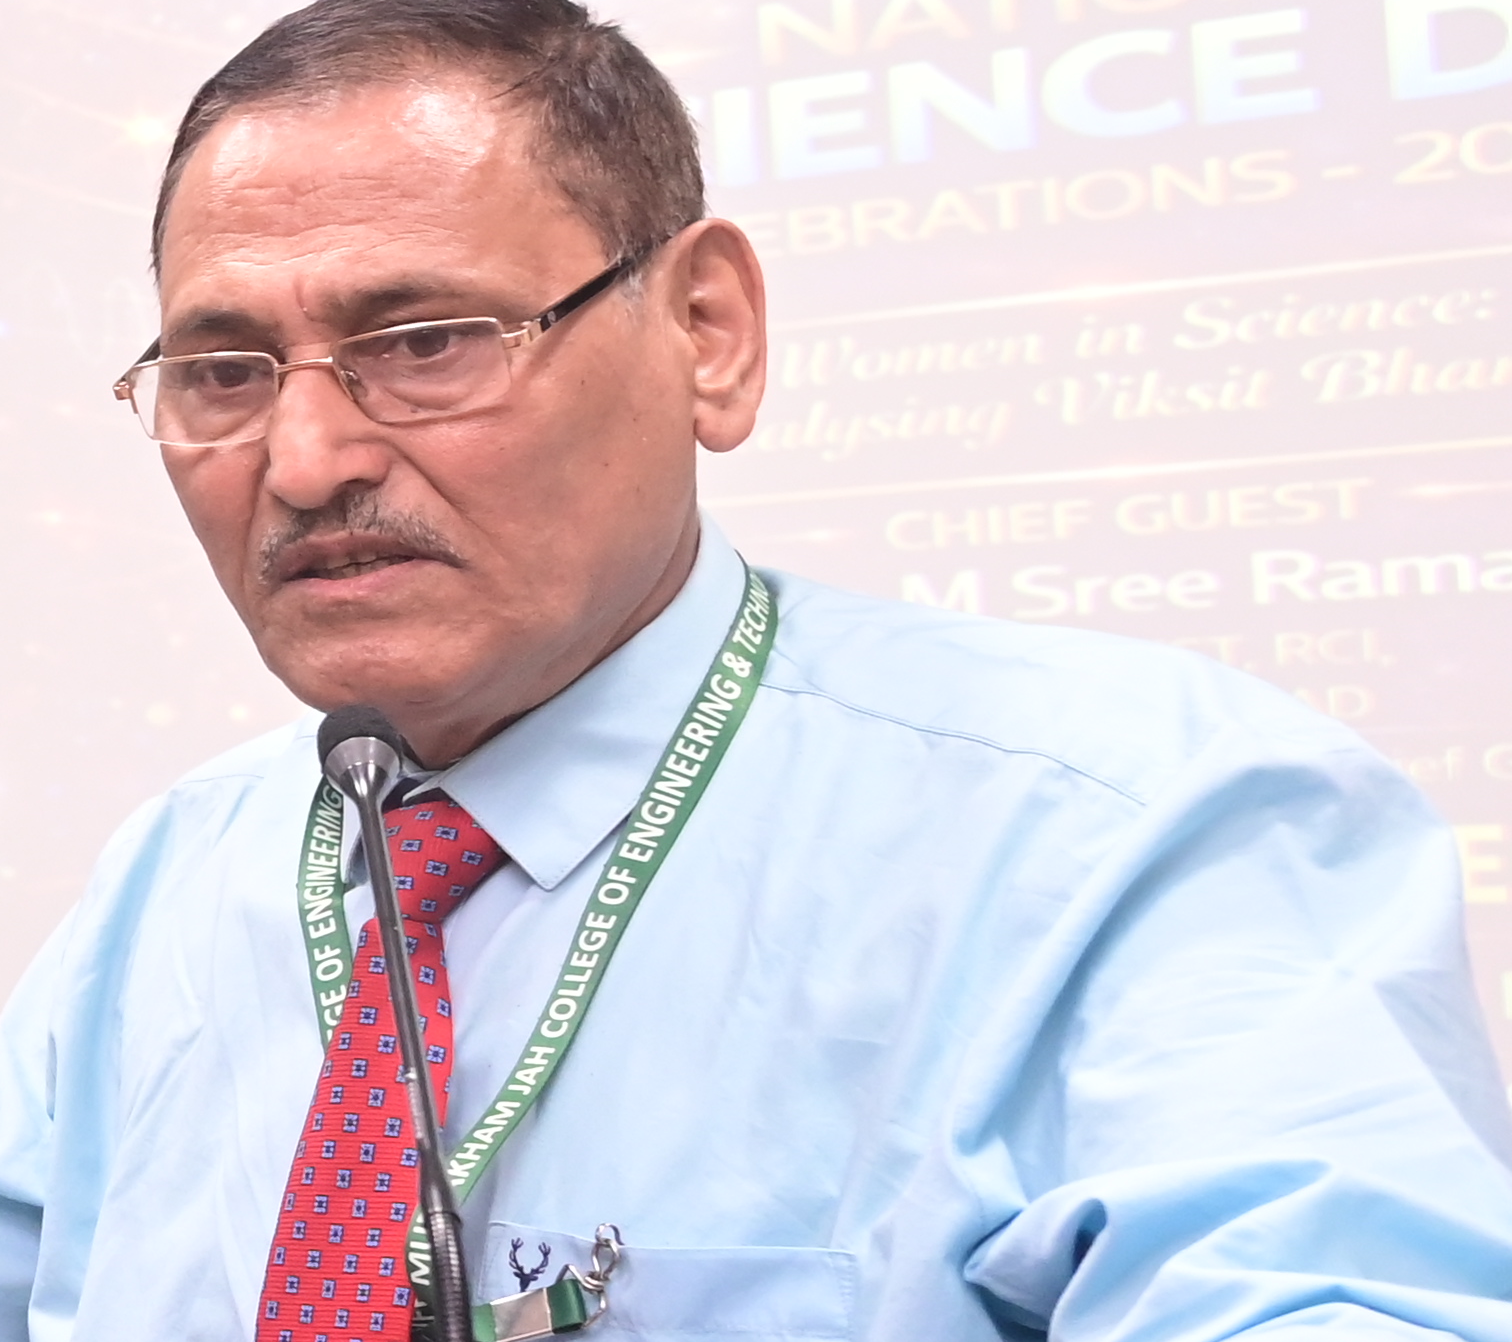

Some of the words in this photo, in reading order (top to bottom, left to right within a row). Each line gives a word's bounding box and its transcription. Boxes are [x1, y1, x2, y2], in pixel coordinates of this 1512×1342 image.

[710, 5, 1320, 191] IENCE
[758, 147, 1299, 256] EBRATIONS
[776, 326, 1046, 393] Women
[1072, 313, 1146, 358] in
[1170, 289, 1498, 351] Science:
[1032, 368, 1274, 429] Viksit
[884, 499, 1094, 553] CHIEF
[1114, 476, 1376, 536] GUEST
[1010, 564, 1237, 619] Sree
[303, 783, 344, 940] ENGINEERING
[513, 1043, 559, 1101] JAH
[539, 910, 619, 1043] COLLEGE
[597, 854, 640, 907] OF
[620, 674, 743, 864] ENGINEERING
[721, 651, 754, 678] &
[313, 946, 345, 982] OF
